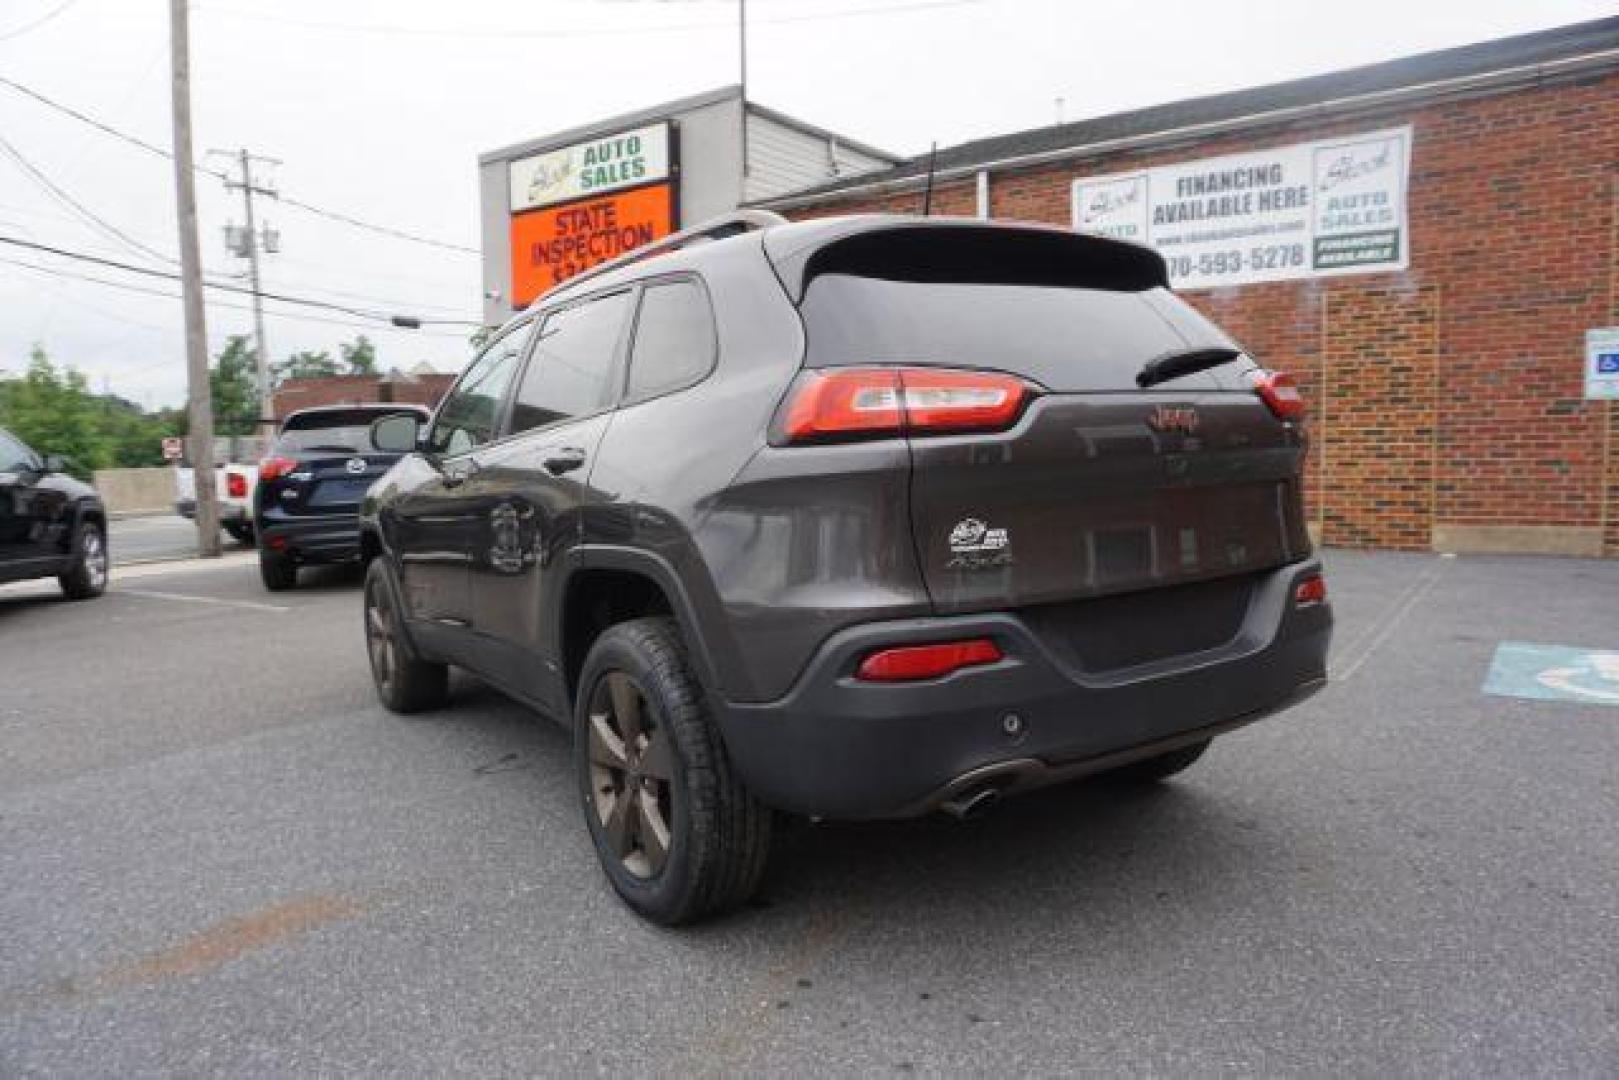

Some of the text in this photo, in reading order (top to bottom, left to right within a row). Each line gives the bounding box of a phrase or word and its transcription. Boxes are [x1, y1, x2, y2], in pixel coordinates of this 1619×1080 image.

[583, 136, 641, 165] AUTO
[579, 157, 646, 187] SALES
[1176, 163, 1283, 198] FINANCING
[1153, 190, 1252, 225] AVAILABLE
[1259, 185, 1308, 213] HERE
[1326, 191, 1388, 211] AUTO
[555, 202, 617, 236] STATE
[1320, 208, 1393, 230] SALES
[530, 222, 655, 266] INSPECTION
